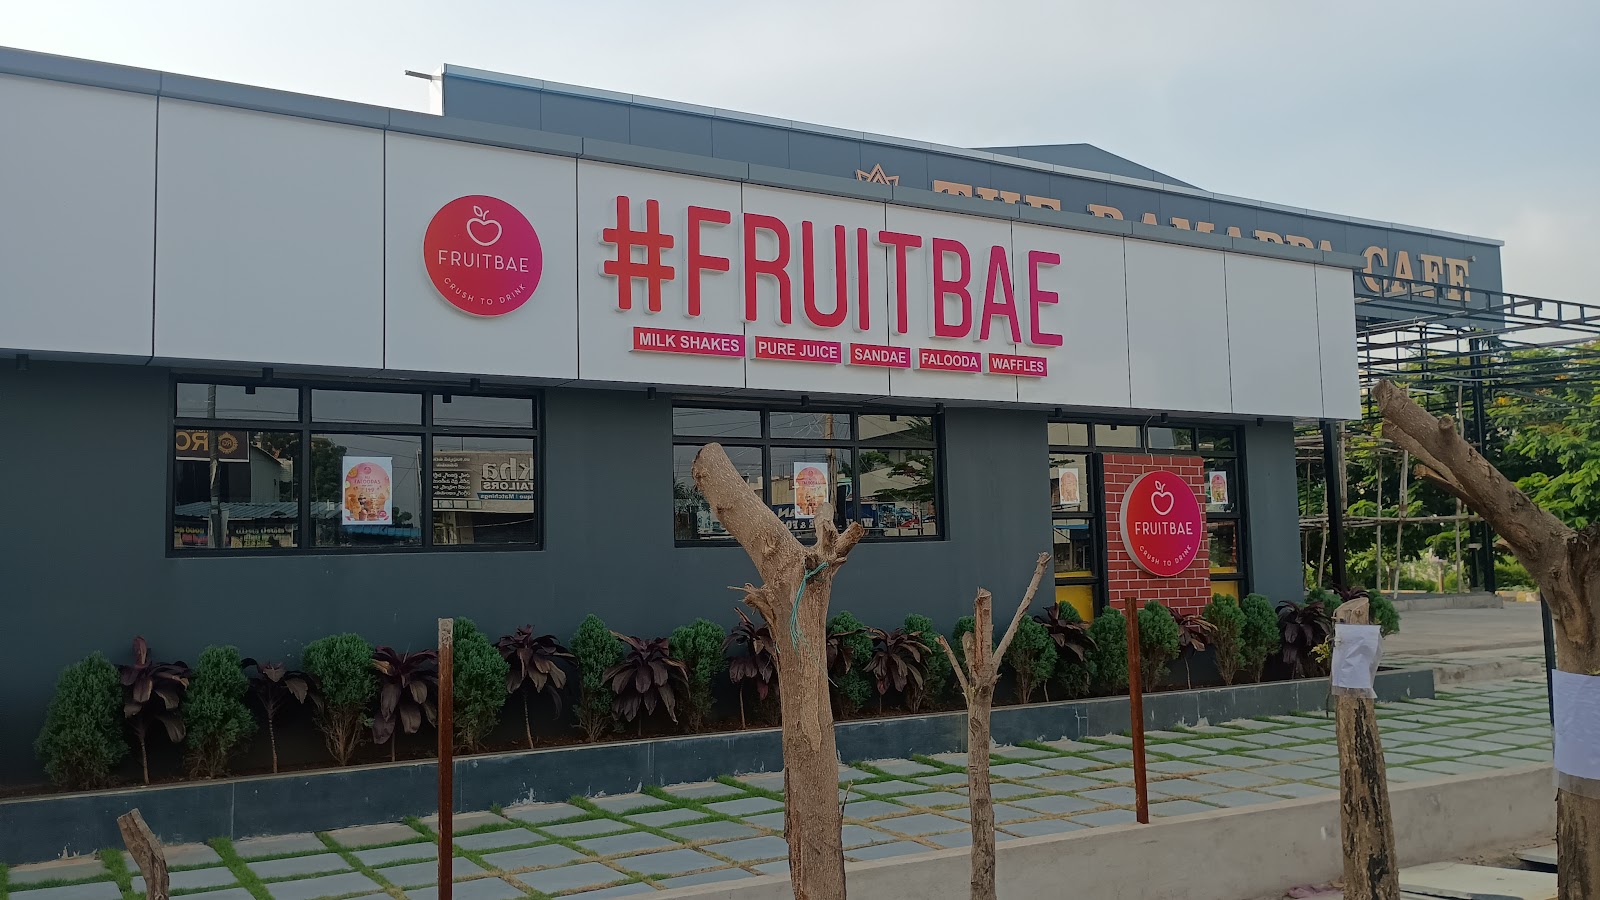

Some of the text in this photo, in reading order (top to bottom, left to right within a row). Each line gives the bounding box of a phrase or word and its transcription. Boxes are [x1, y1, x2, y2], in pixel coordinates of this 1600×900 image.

[437, 249, 529, 274] FRUITBAE
[602, 195, 1064, 347] #FRUITBAE
[443, 277, 527, 306] CRUSH TO DRINK
[639, 332, 740, 352] MILK SHAKES
[758, 341, 838, 359] PURE JUICE
[854, 348, 907, 364] SANDAE
[921, 353, 978, 368] FALOODA
[992, 357, 1045, 373] WAFFLES
[1134, 521, 1193, 535] FRUITBAE
[1139, 544, 1192, 567] CRUSH TO DRINK
